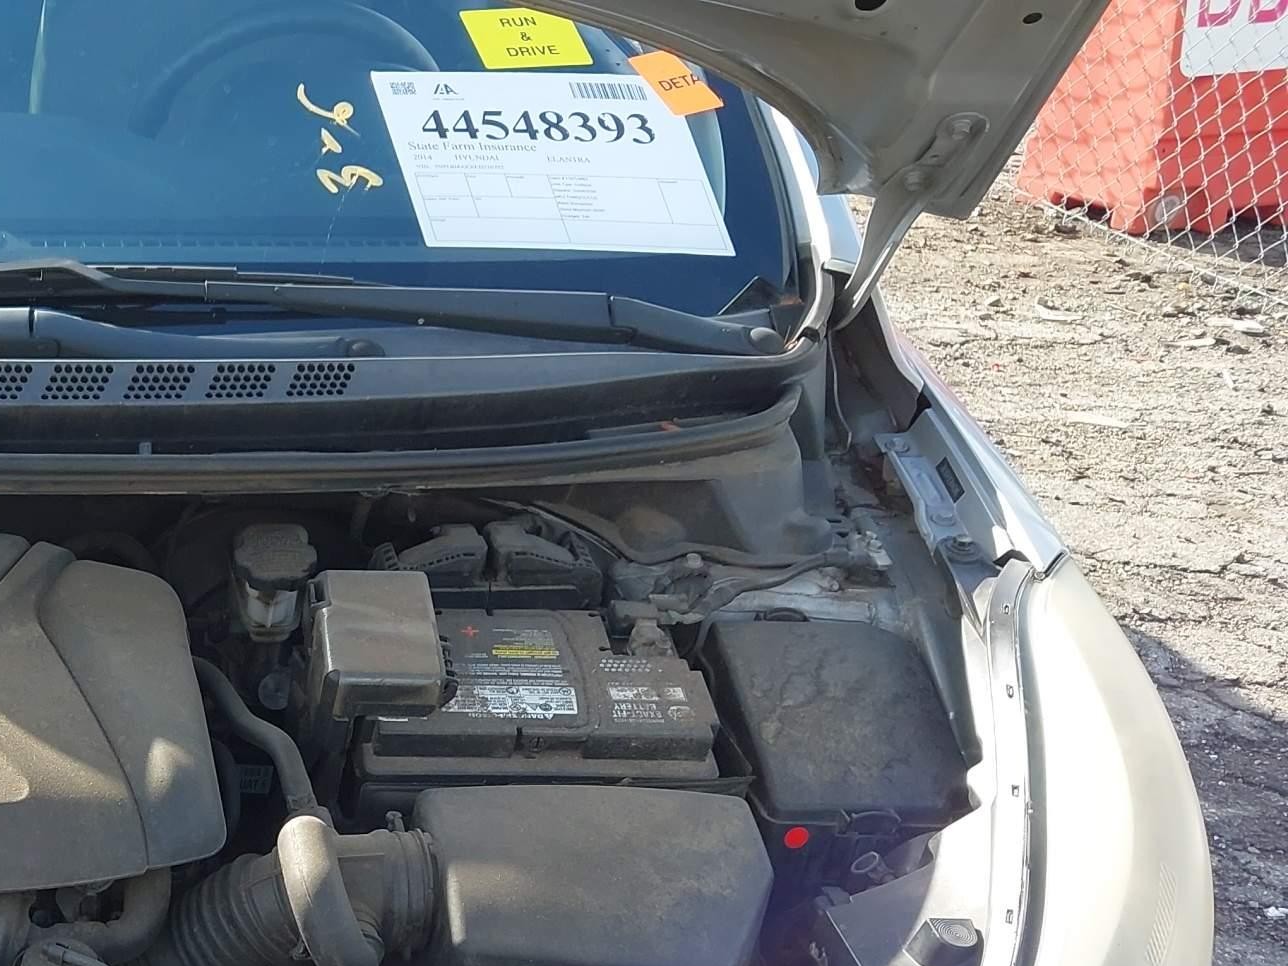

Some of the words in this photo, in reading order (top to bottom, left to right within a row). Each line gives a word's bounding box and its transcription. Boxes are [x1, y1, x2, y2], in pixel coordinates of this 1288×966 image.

[499, 16, 537, 28] RUN
[520, 31, 532, 41] &
[506, 45, 560, 57] DRIVE
[421, 109, 656, 144] 44548393
[407, 141, 439, 151] State
[442, 142, 474, 151] Farm
[478, 142, 537, 152] Insurance
